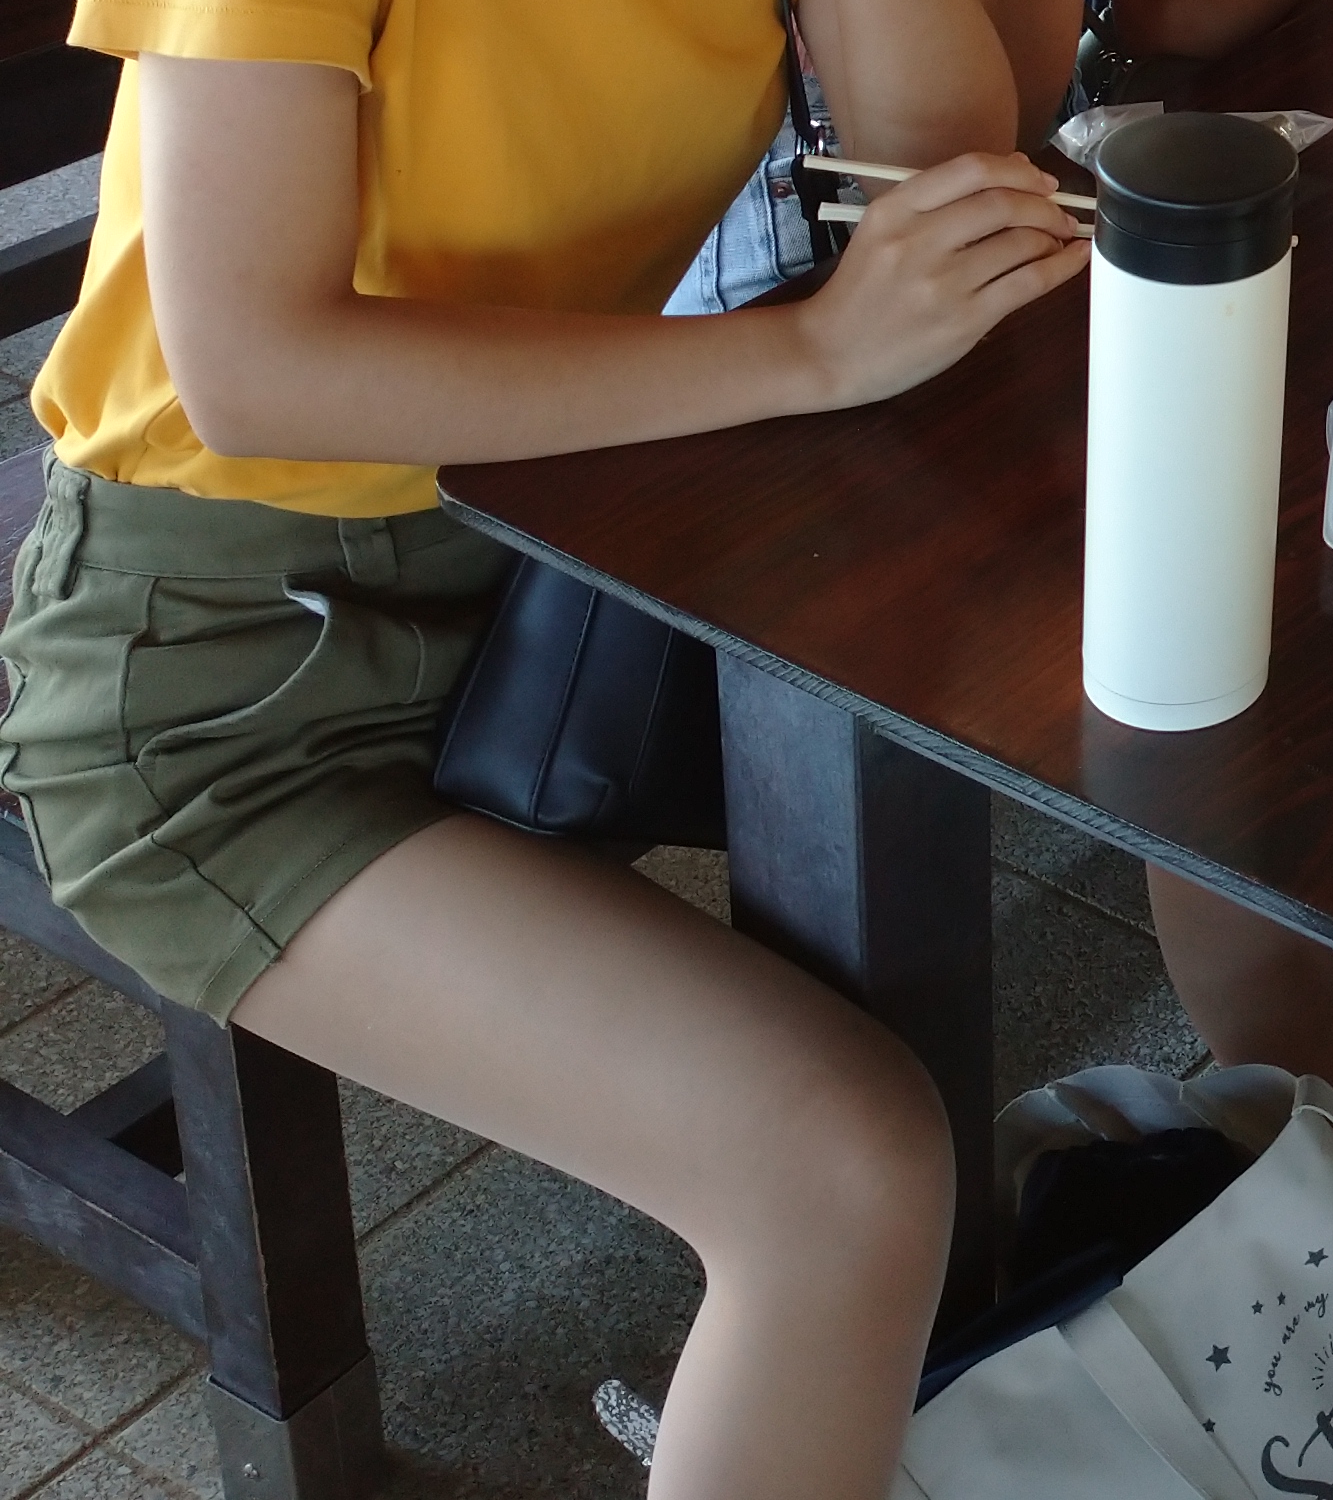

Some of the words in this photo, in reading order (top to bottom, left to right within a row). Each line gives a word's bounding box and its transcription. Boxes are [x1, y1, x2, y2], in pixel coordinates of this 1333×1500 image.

[1264, 1350, 1283, 1396] you
[1281, 1314, 1300, 1345] are
[1304, 1292, 1329, 1318] my
